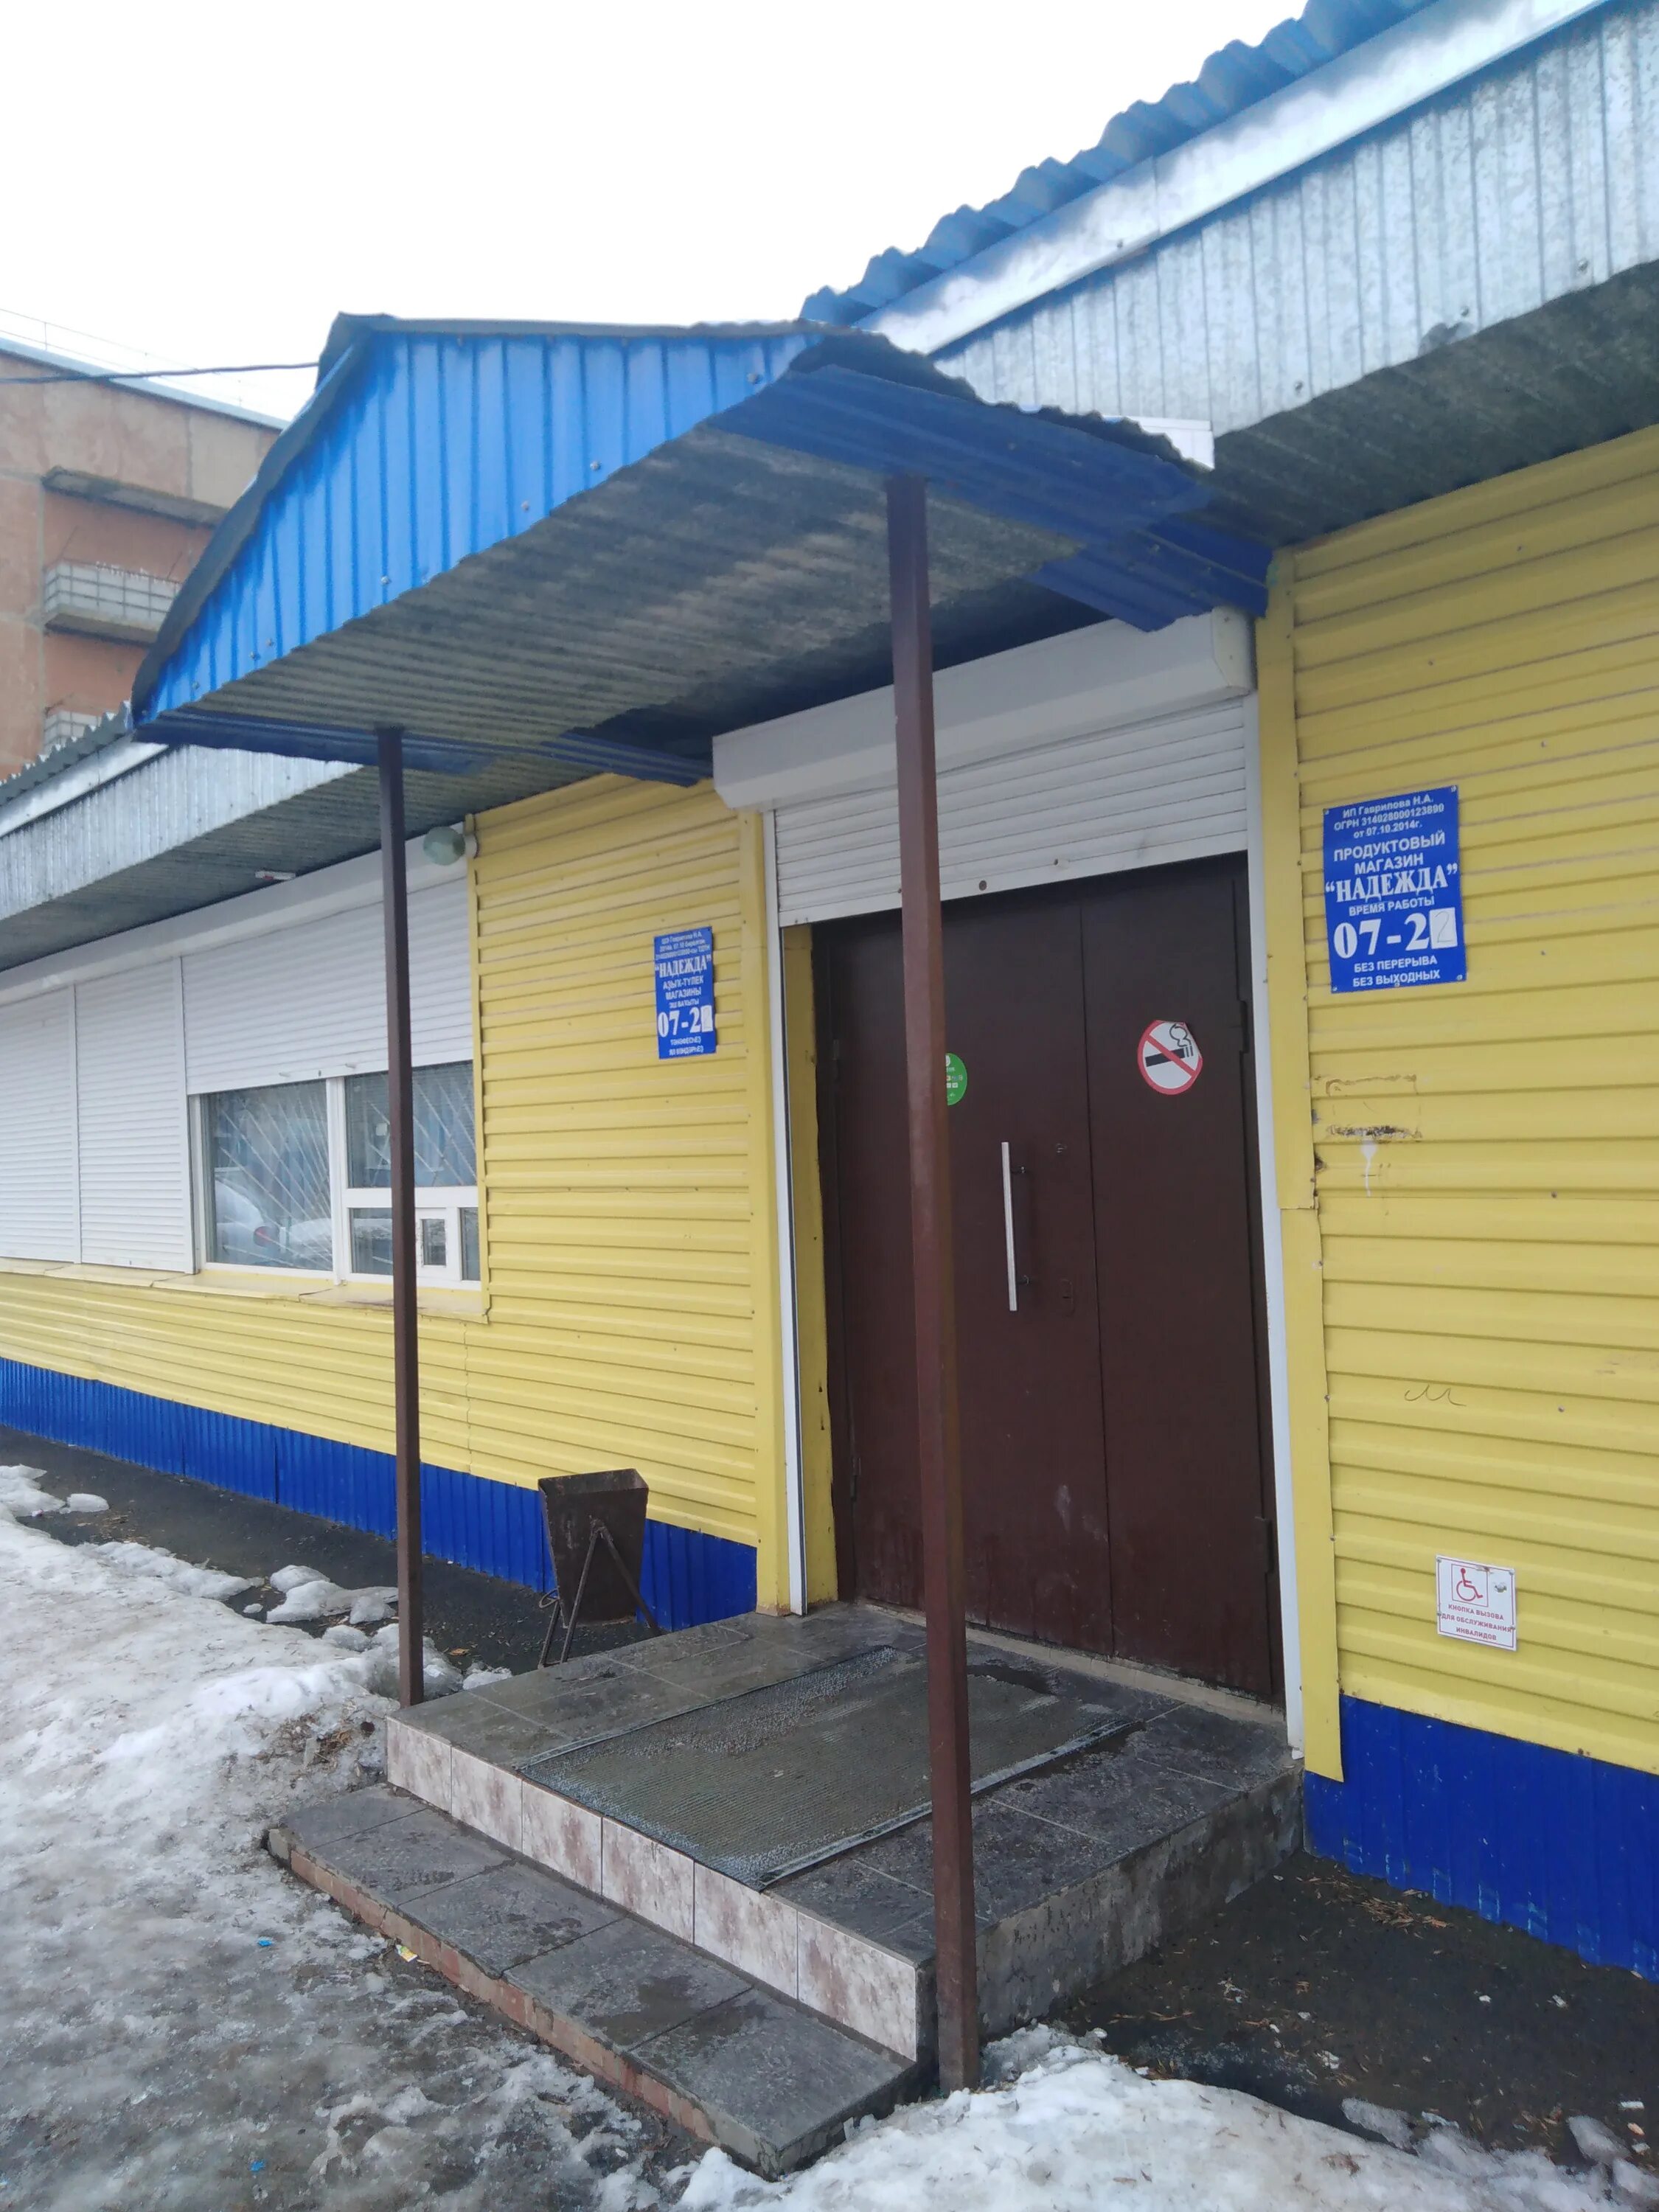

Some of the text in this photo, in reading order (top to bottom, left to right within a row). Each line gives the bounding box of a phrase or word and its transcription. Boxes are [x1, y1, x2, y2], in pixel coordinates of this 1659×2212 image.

[1343, 794, 1434, 818] ИП Гаврилова Н.А.
[1334, 819, 1359, 831] ОГРН
[1366, 820, 1423, 837] 07.10.2014г.
[1333, 830, 1445, 861] ПРОДУКТОВЫЙ
[1354, 852, 1424, 875] МАГАЗИН
[1349, 896, 1435, 917] ВРЕМЯ РАБОТЫ
[1354, 956, 1437, 973] БЕЗ ПЕРЕРЫВА
[1353, 970, 1440, 987] БЕЗ ВЫХОДНЫХ
[666, 987, 701, 1000] МАГАЗИНЫ
[1448, 1604, 1503, 1620] КНОПКА ВЫЗОВА
[1456, 1616, 1512, 1632] ОБСЛУЖИВАНИЯ
[1456, 1627, 1497, 1641] ИНВАЛИДОВ
